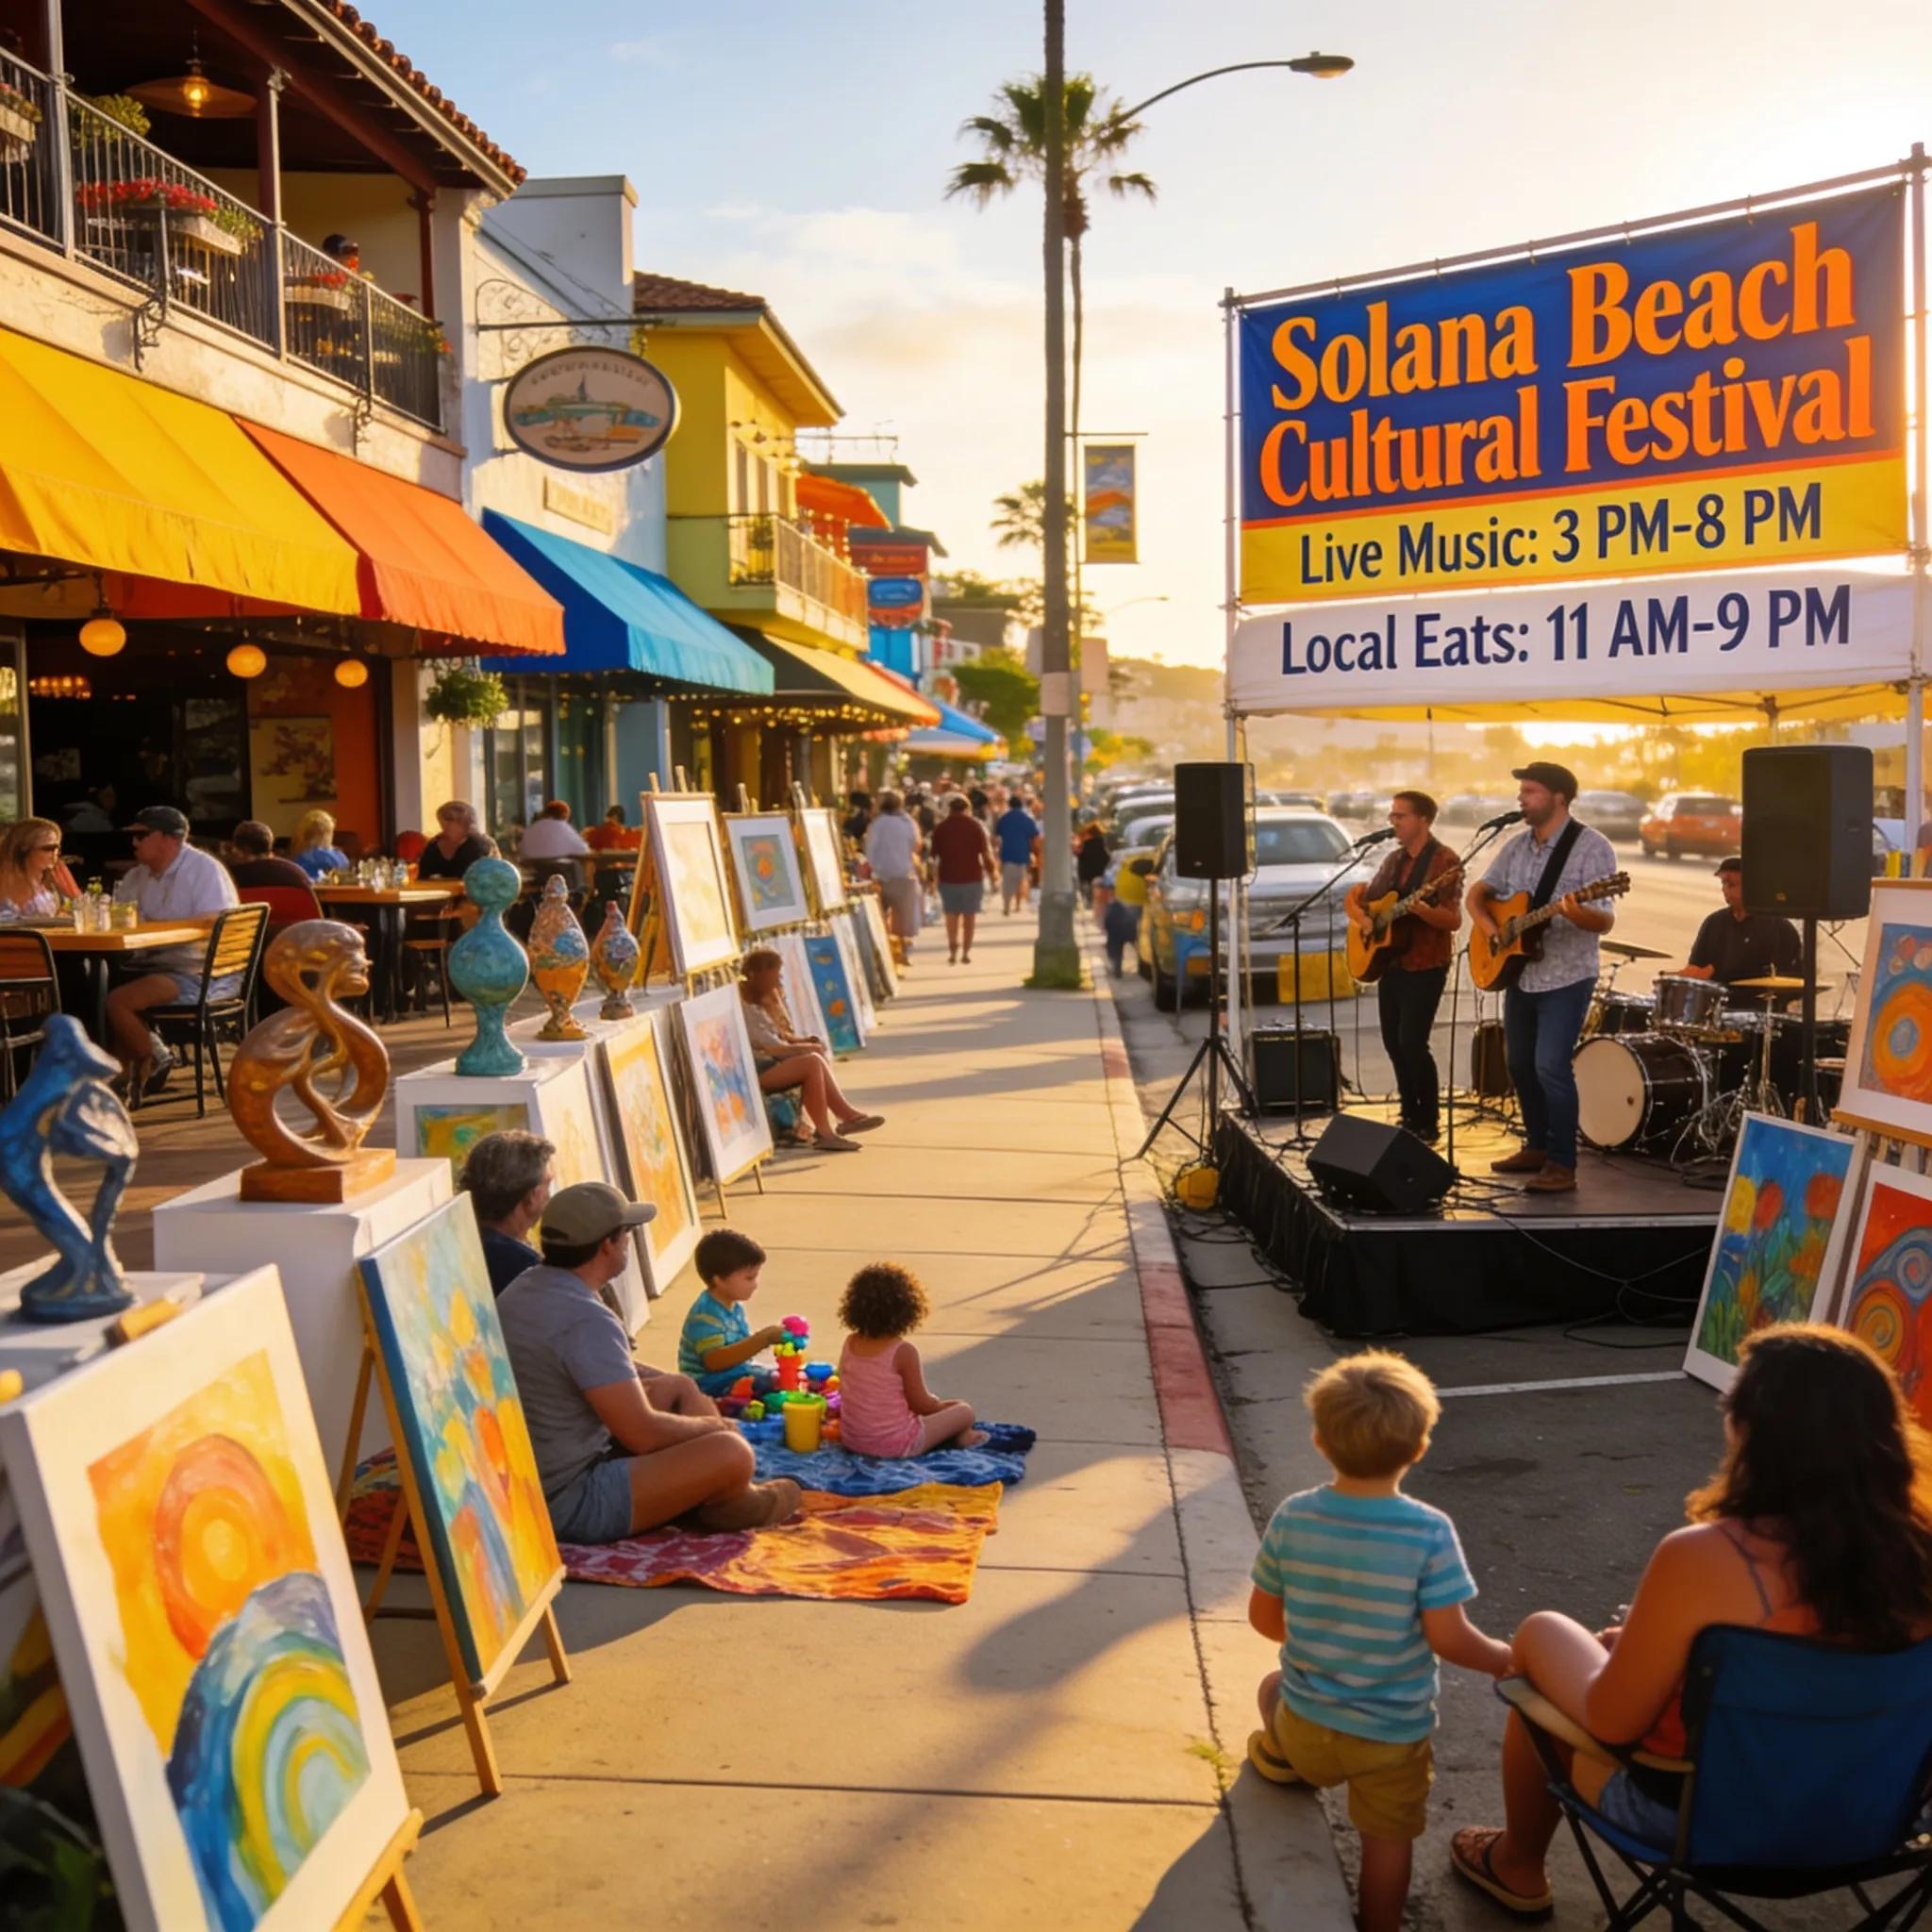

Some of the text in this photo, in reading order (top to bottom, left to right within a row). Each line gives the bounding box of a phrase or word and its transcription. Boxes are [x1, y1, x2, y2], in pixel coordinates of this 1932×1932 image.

[1271, 221, 1856, 411] Solana Beach
[1259, 335, 1875, 507] Cultural Festival
[1300, 533, 1383, 585] Live
[1397, 516, 1538, 577] Music:
[1552, 508, 1580, 564] 3
[1743, 482, 1822, 544] PM
[1281, 614, 1397, 675] Local
[1414, 613, 1530, 671] Eats:
[1545, 601, 1589, 660] 11
[1768, 584, 1852, 649] PM
